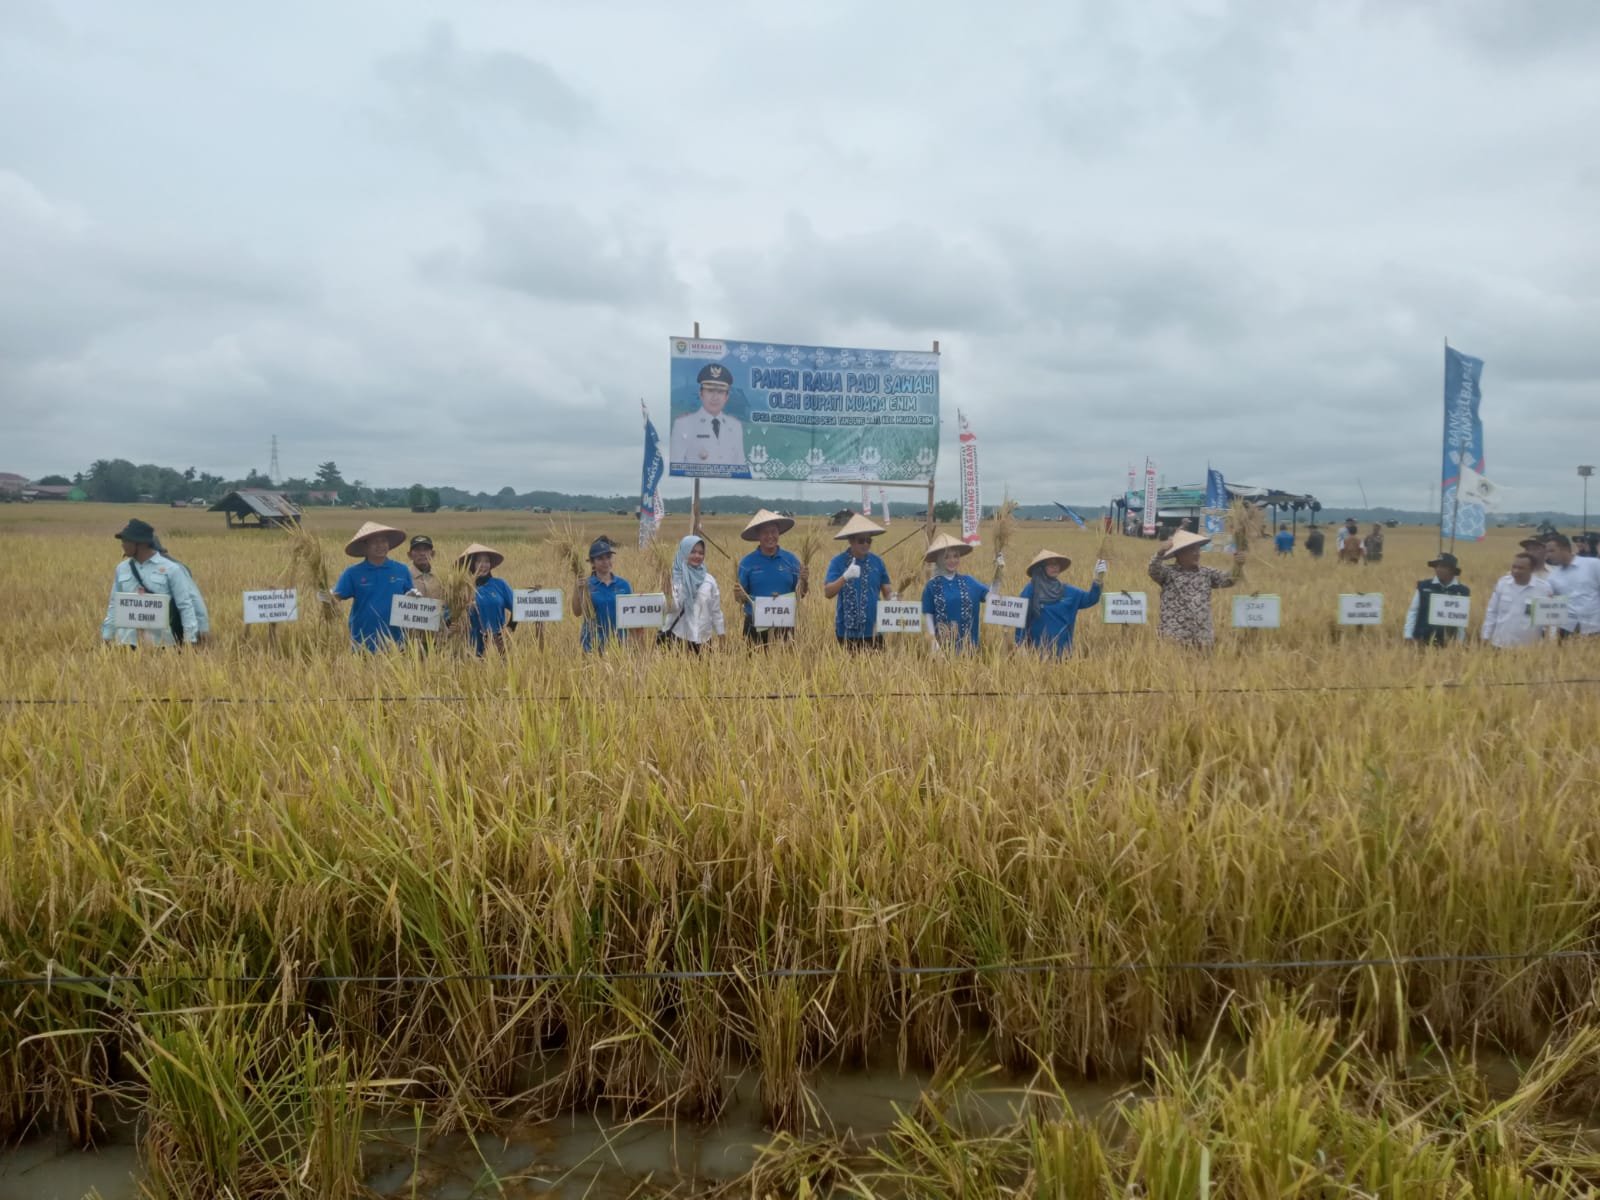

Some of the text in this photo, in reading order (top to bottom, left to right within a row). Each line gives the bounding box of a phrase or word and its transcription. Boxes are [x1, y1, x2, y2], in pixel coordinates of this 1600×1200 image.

[751, 367, 934, 395] PANEN RAYA PADI SAWAH
[768, 391, 917, 412] OLEH BUPATI MUARA ENIM
[1448, 408, 1460, 447] BANK
[966, 444, 975, 487] SERASAN
[120, 599, 143, 608] KETUA
[623, 605, 661, 614] PT DBU
[764, 606, 790, 615] PTBA
[884, 606, 919, 614] BUPATI
[128, 612, 156, 621] M. ENIM
